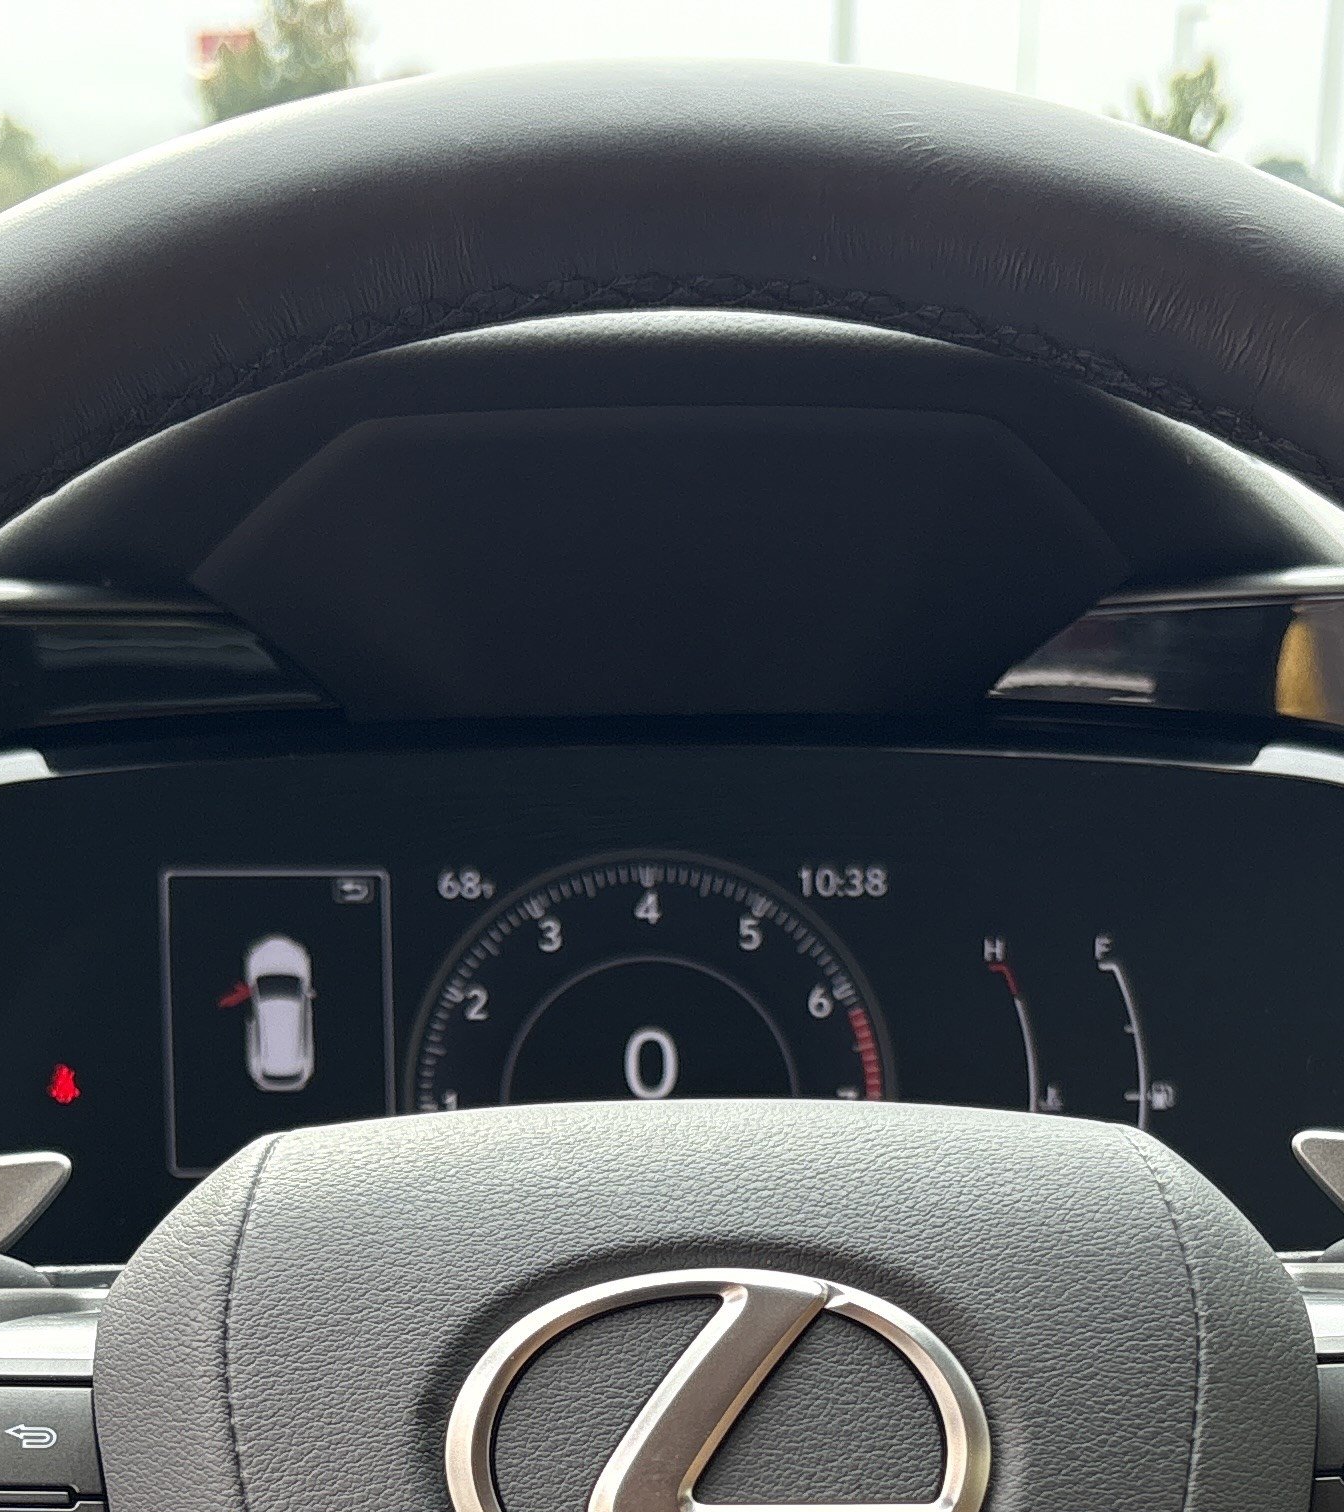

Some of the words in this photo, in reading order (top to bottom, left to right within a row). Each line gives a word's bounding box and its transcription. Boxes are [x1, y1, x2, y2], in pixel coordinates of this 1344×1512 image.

[799, 866, 887, 897] 10:38
[634, 892, 661, 924] 4
[538, 918, 562, 951] 3
[739, 917, 762, 950] 5
[983, 937, 1004, 962] H
[1094, 935, 1112, 960] F
[464, 986, 488, 1020] 2
[807, 985, 834, 1019] 6
[624, 1027, 678, 1099] 0
